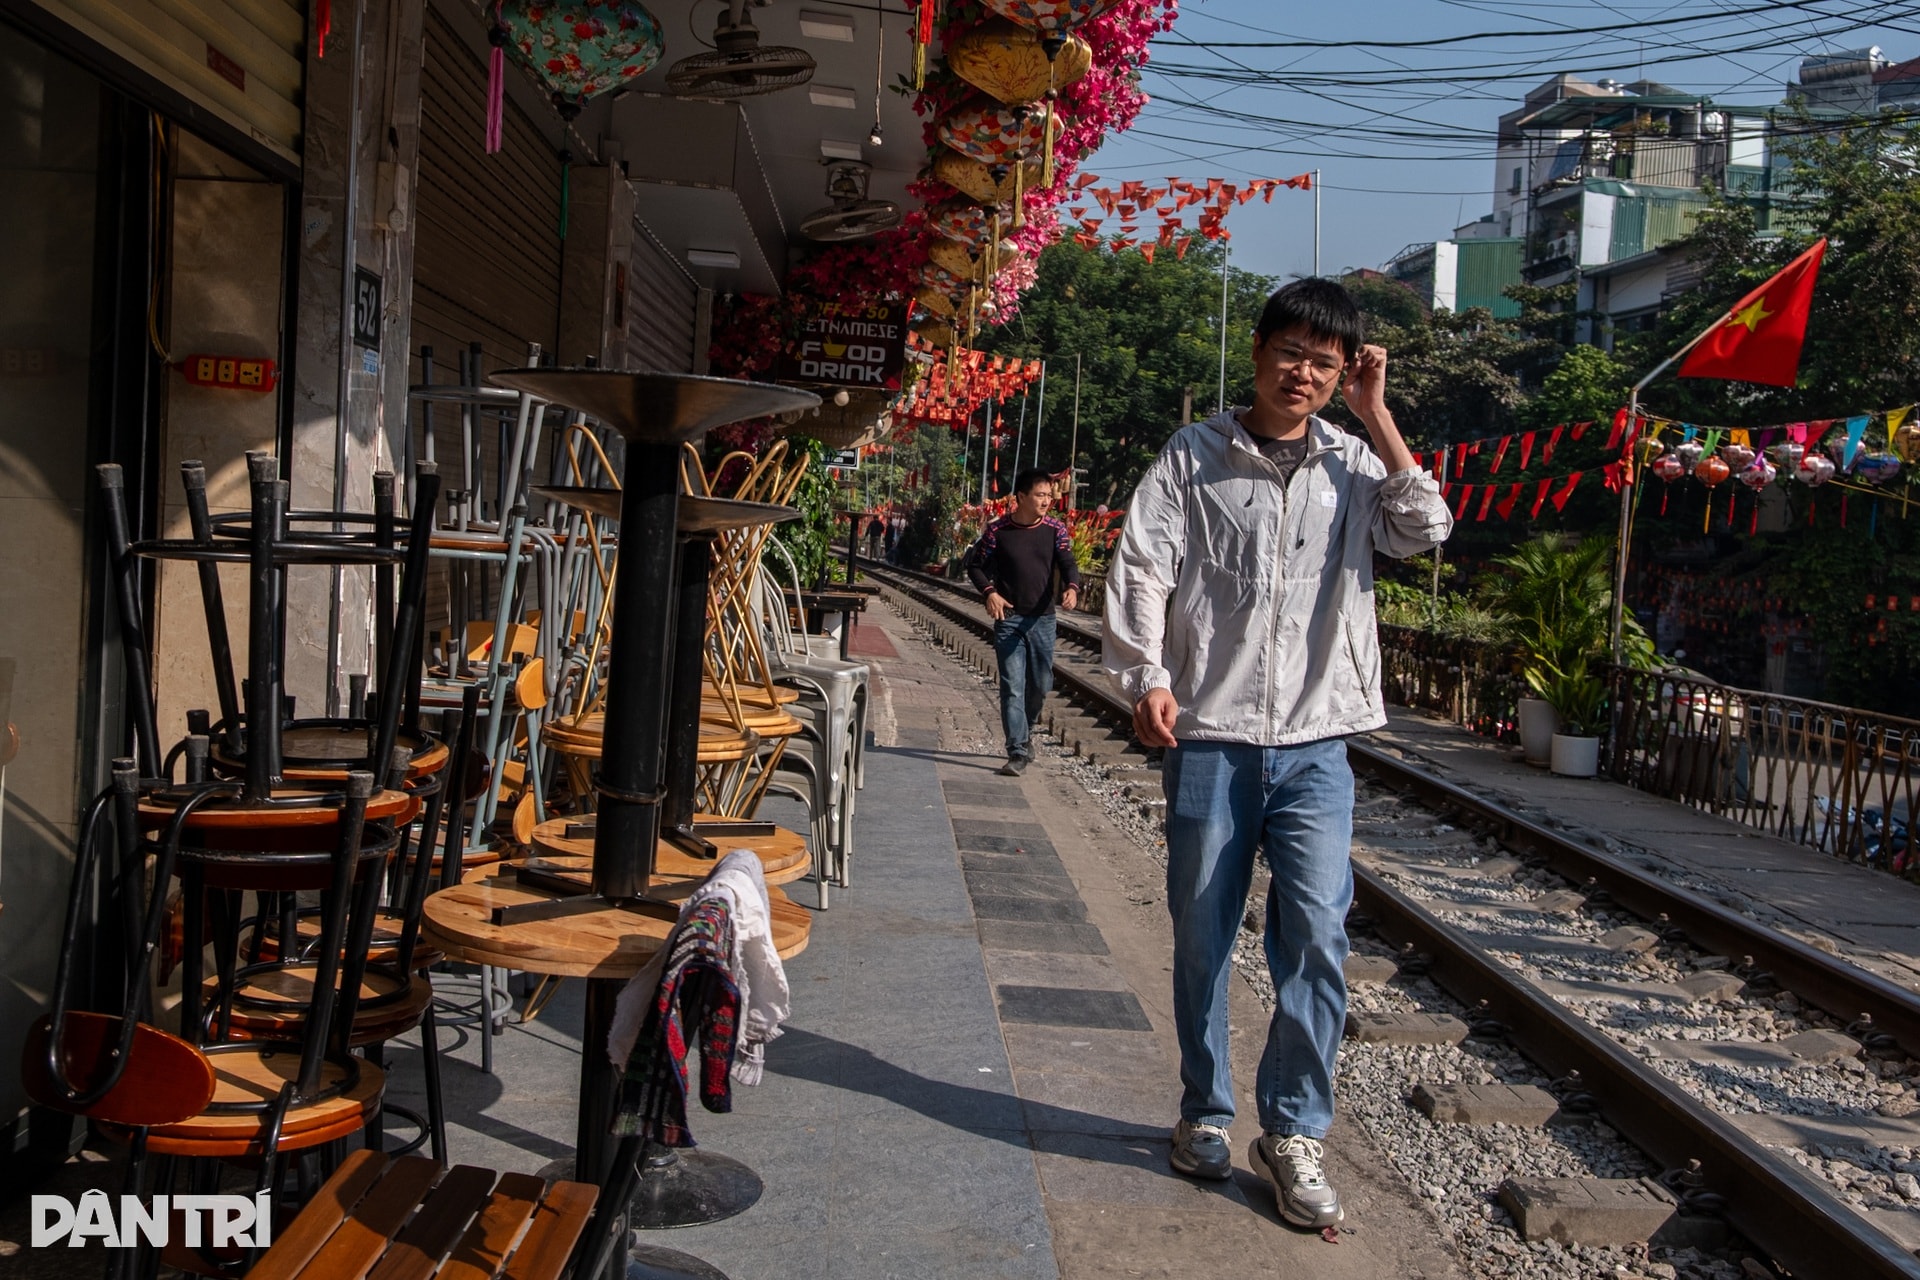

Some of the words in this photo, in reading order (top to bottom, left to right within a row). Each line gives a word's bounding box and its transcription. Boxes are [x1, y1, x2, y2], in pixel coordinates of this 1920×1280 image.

[358, 279, 377, 337] 52
[866, 305, 890, 321] 50
[804, 318, 899, 340] ETNAMESE
[800, 359, 885, 383] DRINK
